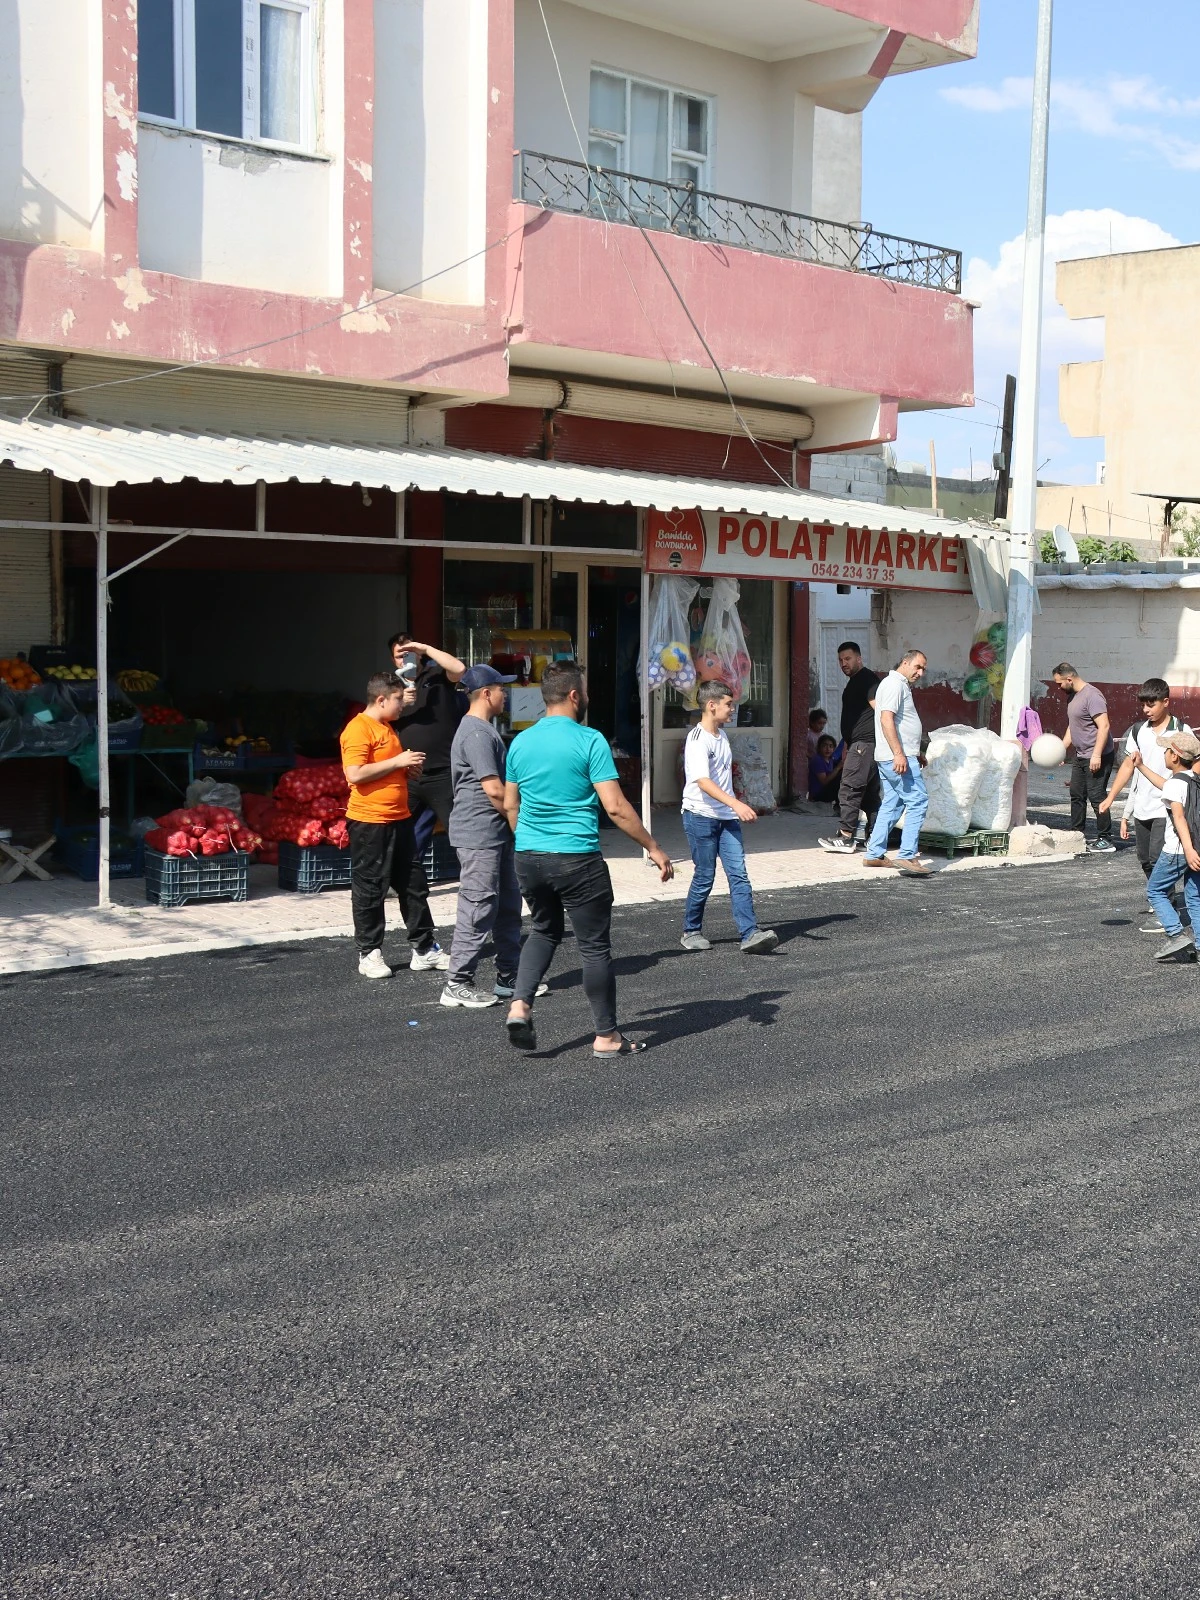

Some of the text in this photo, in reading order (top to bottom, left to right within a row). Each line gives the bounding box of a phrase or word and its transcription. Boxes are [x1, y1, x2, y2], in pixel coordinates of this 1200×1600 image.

[655, 541, 698, 551] DONDURMA
[718, 517, 834, 561] POLAT
[811, 562, 895, 582] 0542 234 37 35
